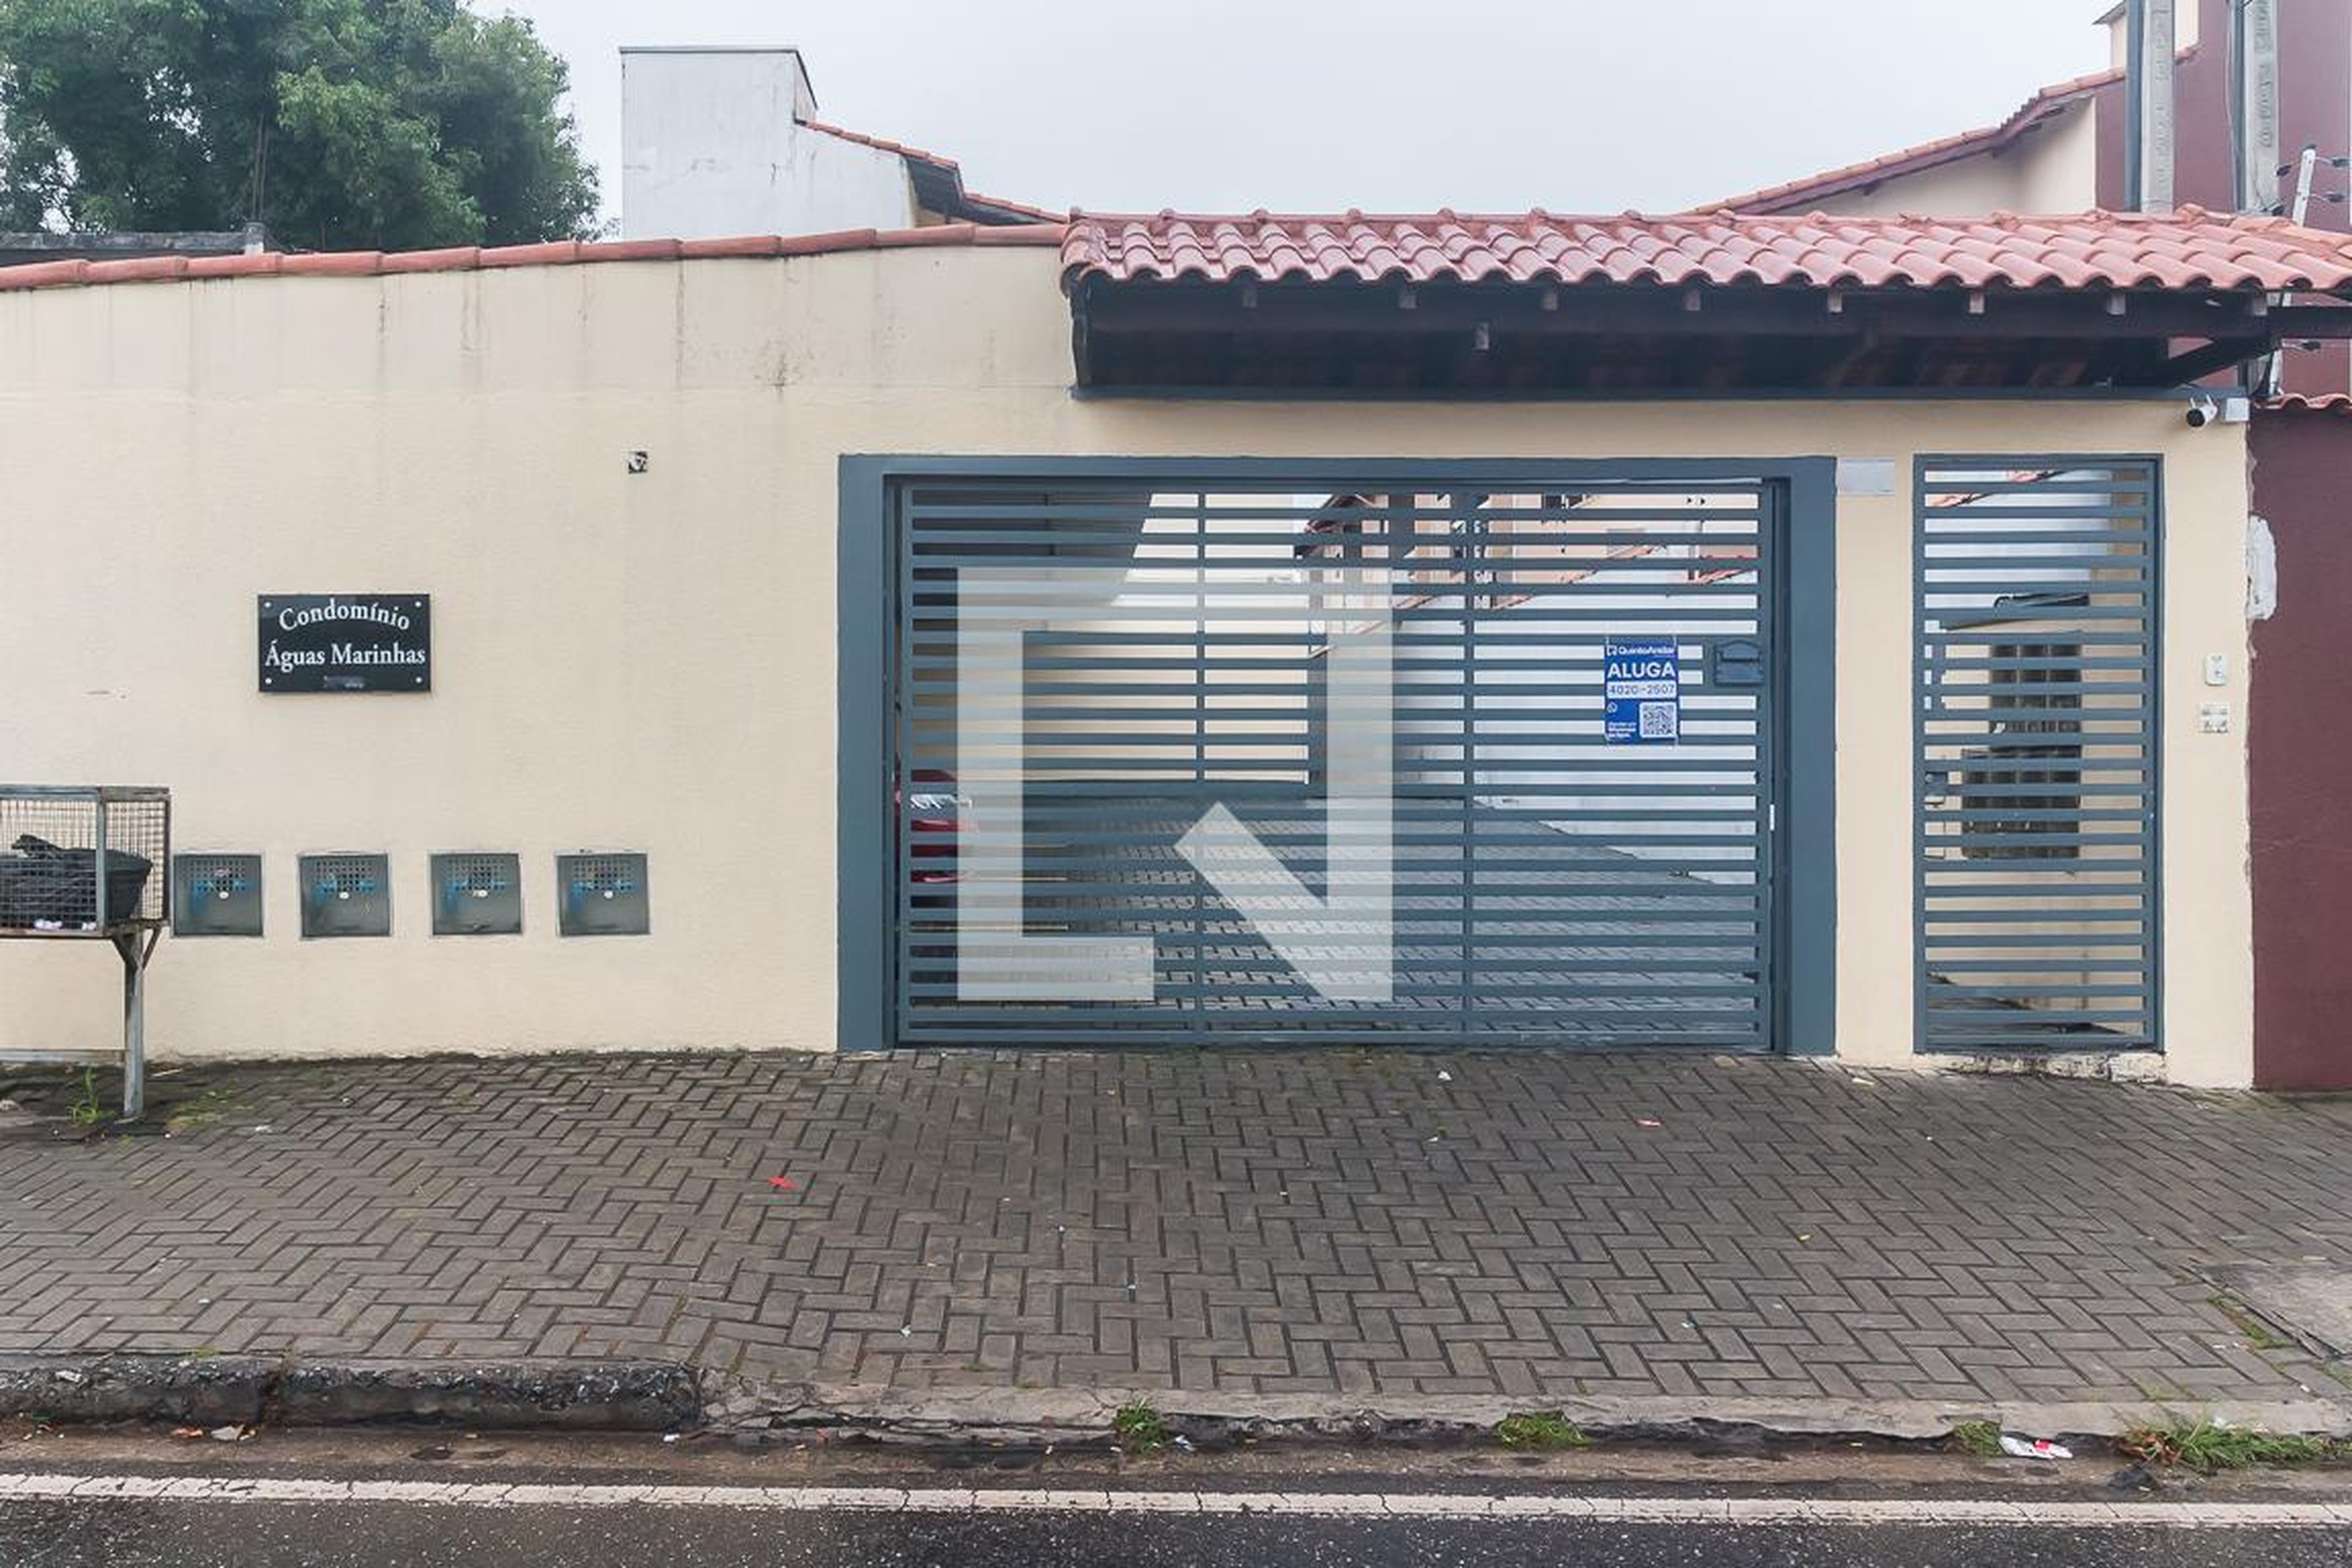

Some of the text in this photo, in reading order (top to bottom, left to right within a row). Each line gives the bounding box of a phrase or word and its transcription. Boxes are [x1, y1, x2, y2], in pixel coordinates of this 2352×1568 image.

[279, 598, 410, 630] Condomínio
[265, 639, 426, 673] Águas Marinhas
[1608, 662, 1676, 677] ALUGA
